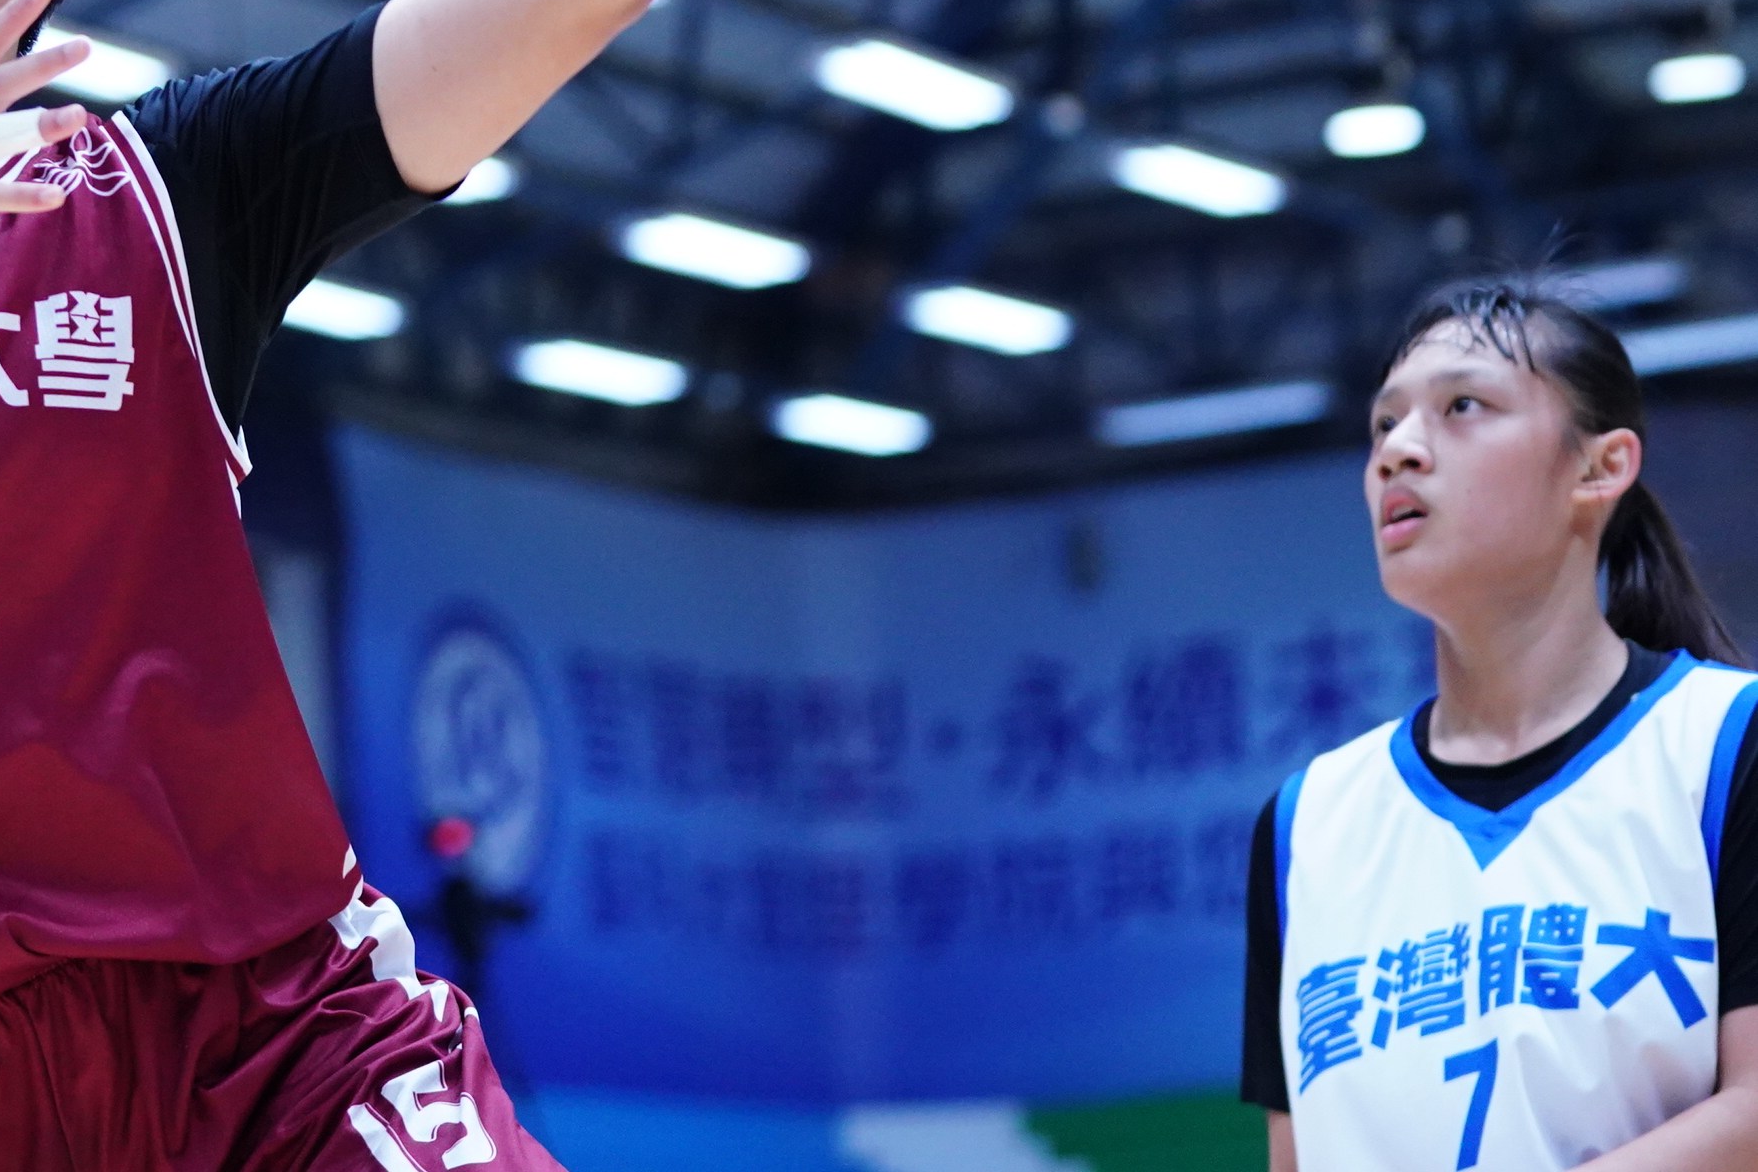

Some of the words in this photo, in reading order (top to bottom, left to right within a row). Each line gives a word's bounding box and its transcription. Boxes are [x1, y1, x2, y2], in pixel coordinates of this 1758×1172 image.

[1296, 903, 1716, 1097] 臺灣體大
[347, 1059, 497, 1172] 15
[1444, 1037, 1499, 1172] 7
